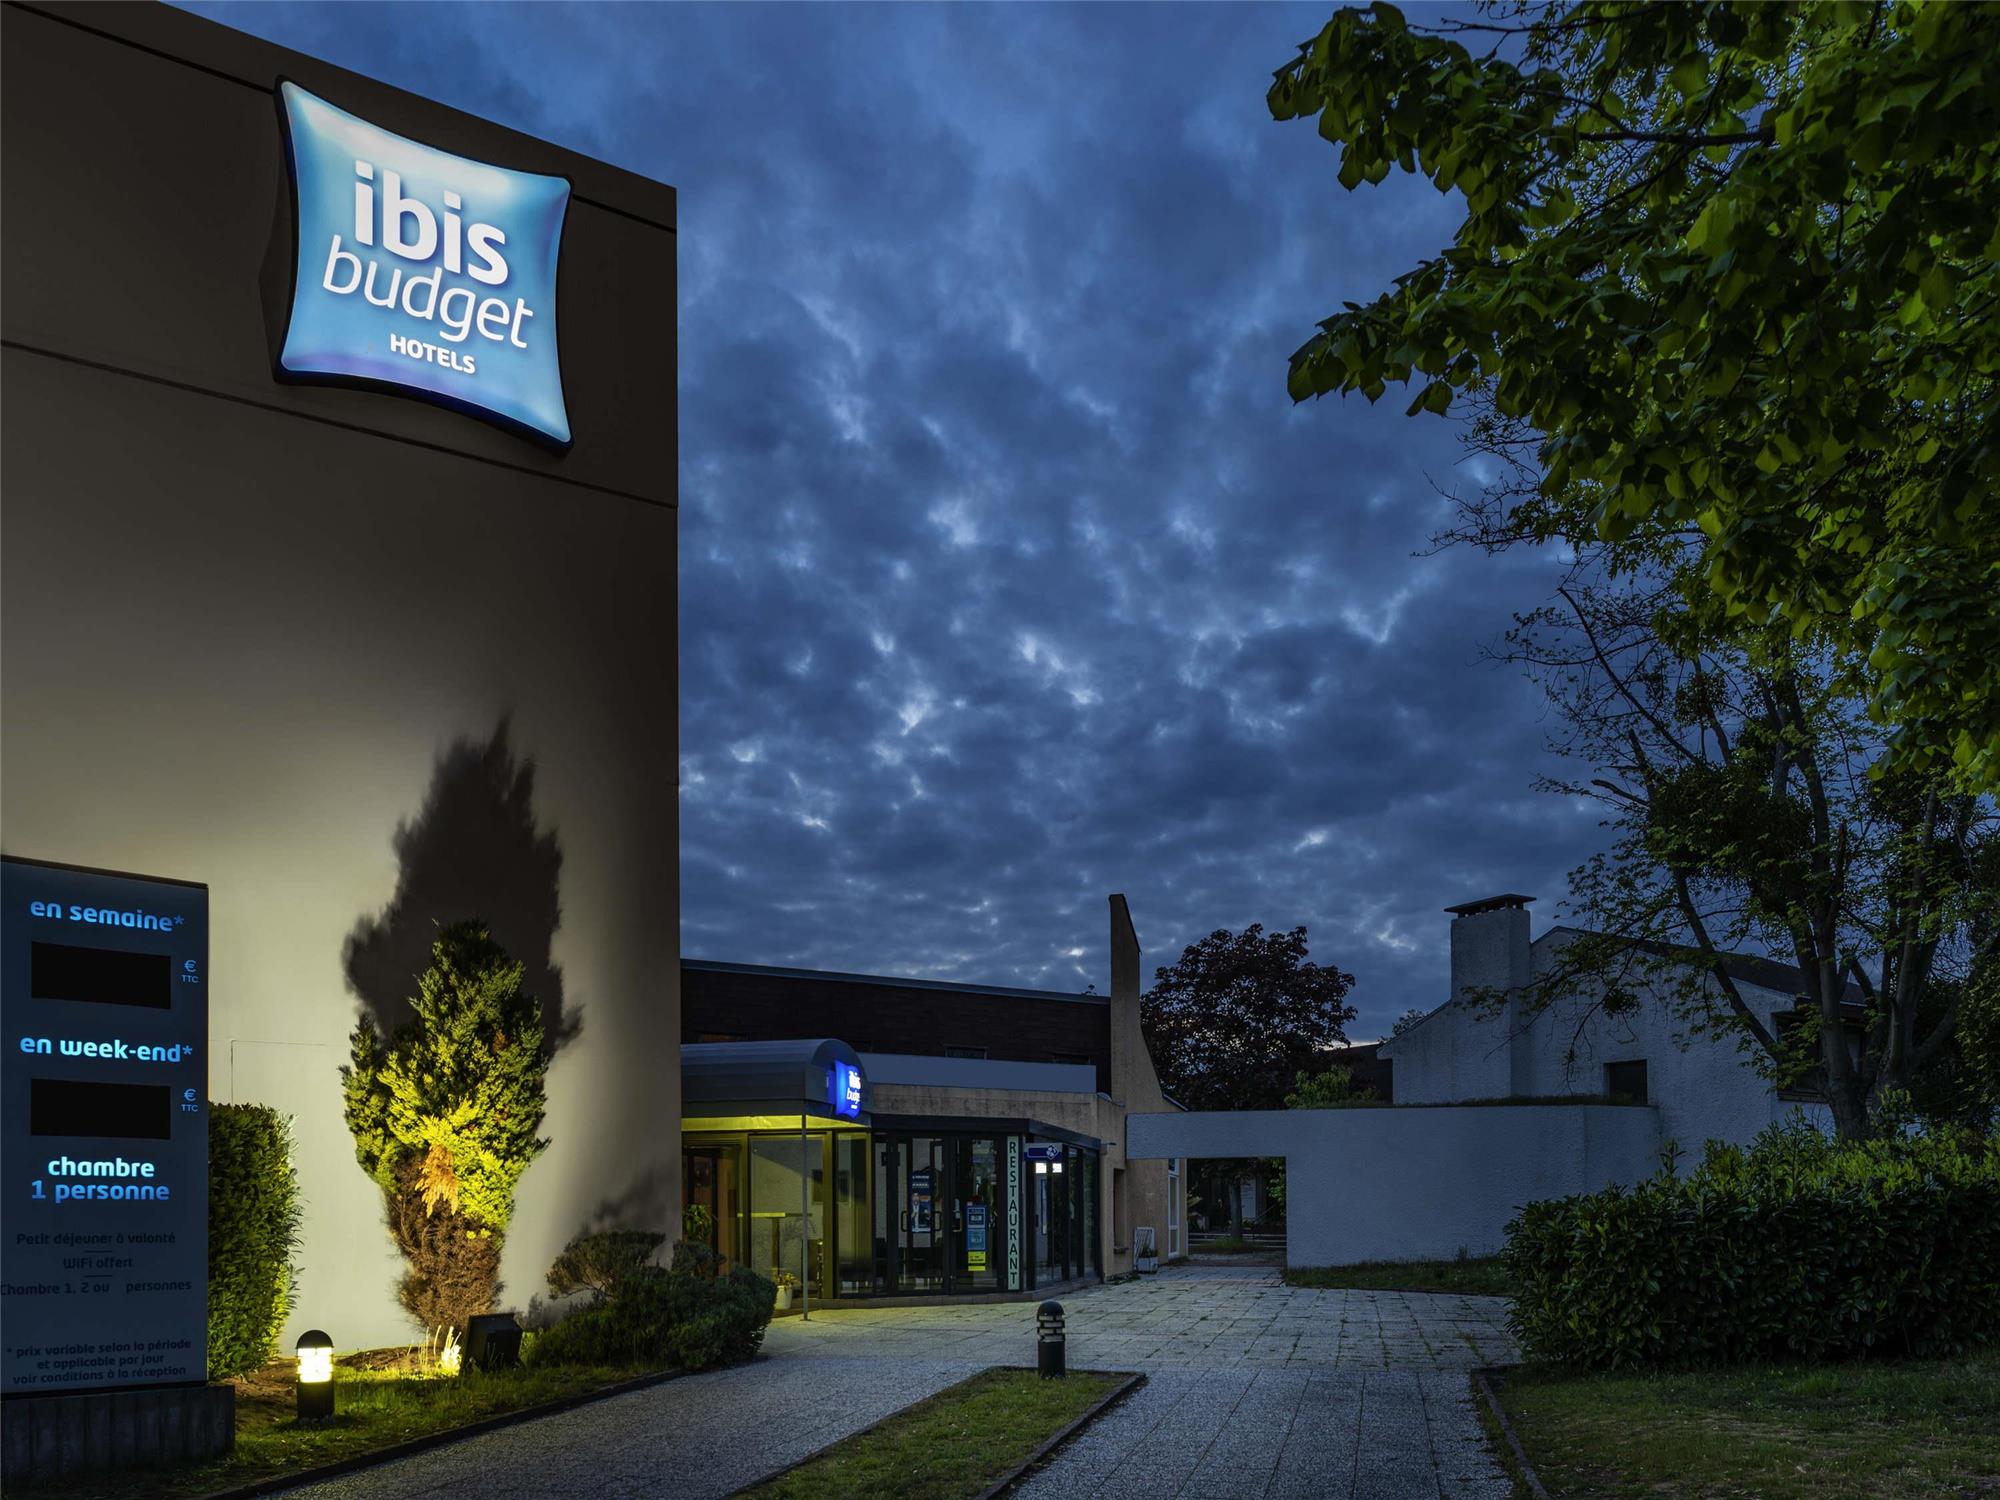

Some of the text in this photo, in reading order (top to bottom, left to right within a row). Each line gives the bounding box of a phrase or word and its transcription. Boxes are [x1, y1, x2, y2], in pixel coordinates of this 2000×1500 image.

[355, 159, 509, 285] ibis
[322, 234, 534, 349] budget
[389, 333, 476, 375] HOTELS
[30, 901, 62, 919] en
[184, 960, 197, 973] €
[181, 974, 199, 984] TTC
[20, 1037, 52, 1054] en
[183, 1088, 197, 1102] €
[181, 1104, 199, 1112] TTC
[48, 1156, 155, 1177] chambre
[31, 1180, 171, 1203] 1 personne
[1008, 1141, 1018, 1284] RESTAURANT
[16, 1233, 50, 1245] Petit
[53, 1232, 113, 1247] déjeuner
[128, 1232, 176, 1245] volonté
[63, 1256, 134, 1269] WiFi offert
[81, 1282, 89, 1293] 2
[93, 1284, 110, 1293] ou
[126, 1280, 193, 1293] personnes
[16, 1344, 42, 1359] prix
[45, 1343, 96, 1356] variable
[98, 1341, 130, 1353] selon
[133, 1340, 145, 1351] la
[147, 1338, 192, 1352] période
[37, 1353, 164, 1371] et applicable par jour
[13, 1373, 38, 1386] voir
[40, 1370, 104, 1384] conditions
[118, 1367, 129, 1379] la
[131, 1365, 187, 1379] réception
